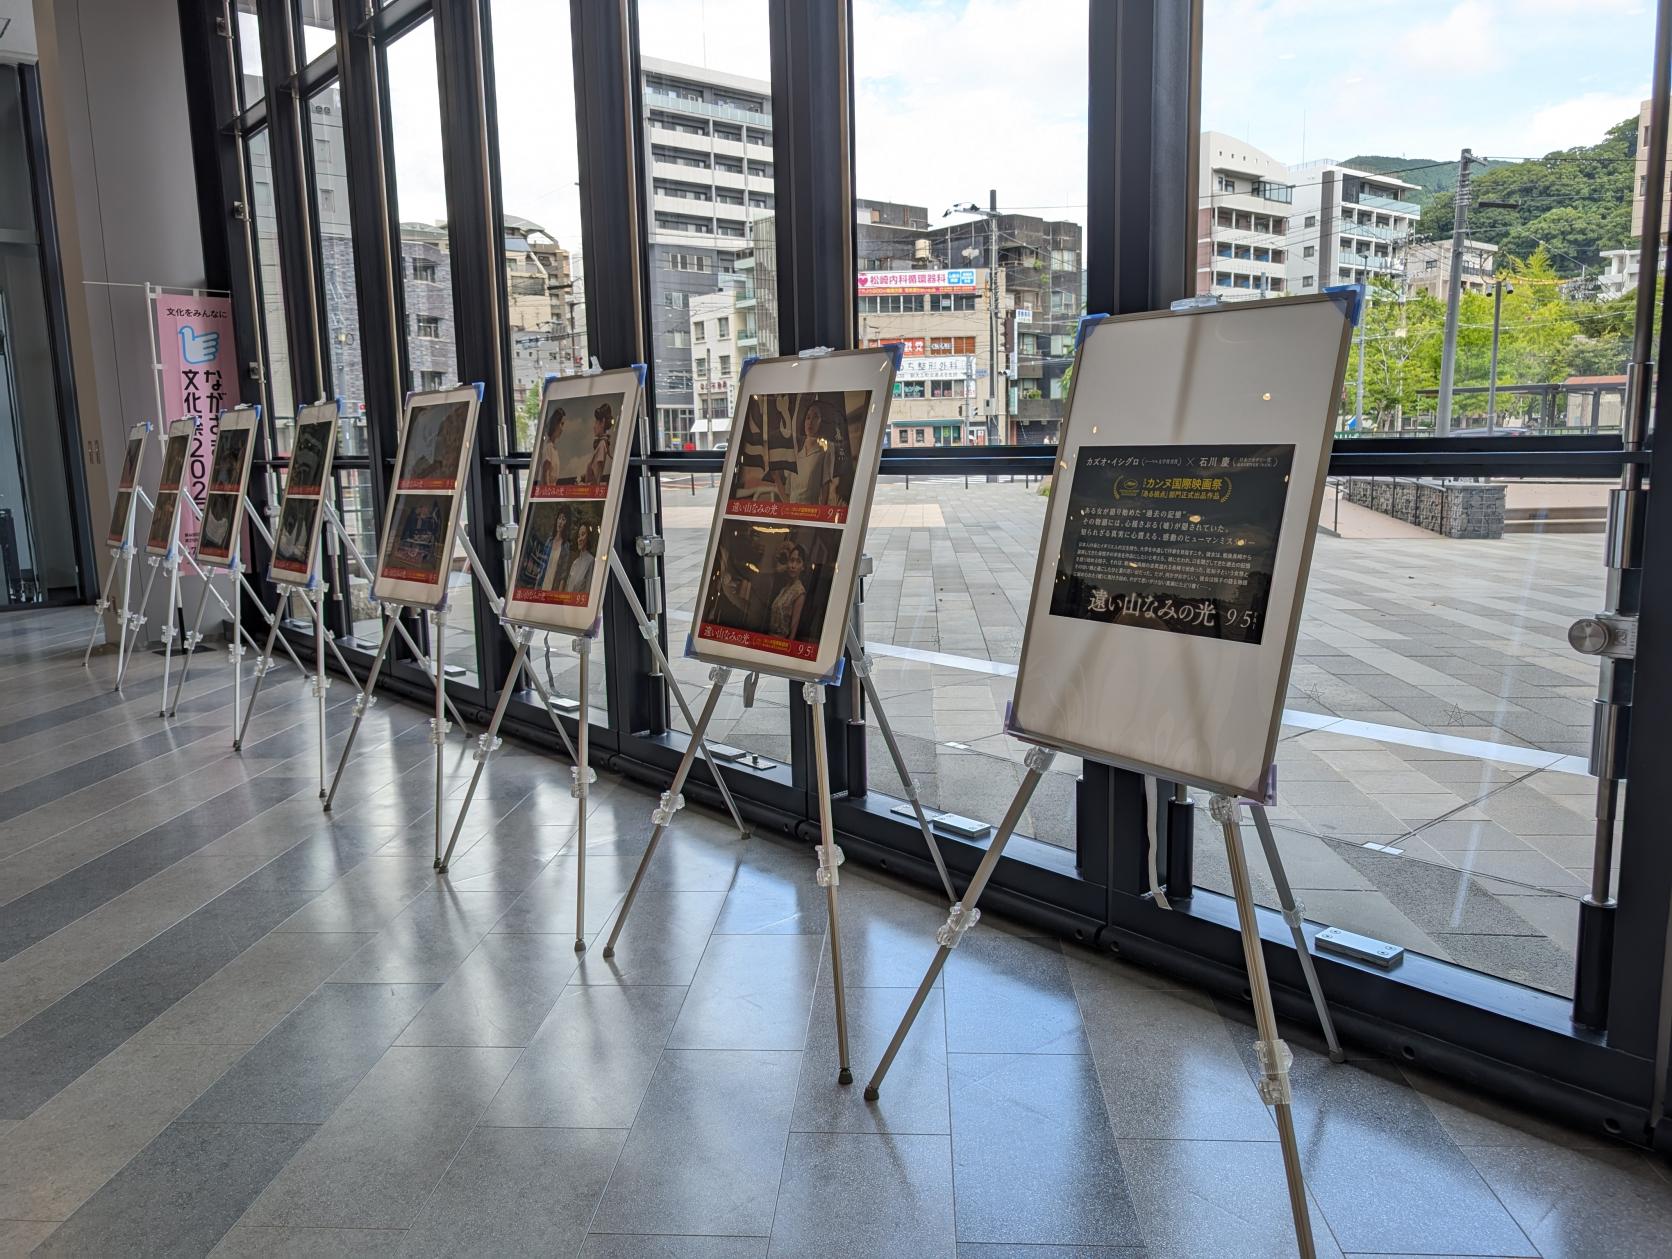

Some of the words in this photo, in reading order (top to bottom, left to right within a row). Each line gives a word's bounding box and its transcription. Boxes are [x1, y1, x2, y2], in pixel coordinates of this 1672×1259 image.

[166, 308, 227, 319] 文化をみんなに
[204, 370, 227, 457] ながさ
[1085, 457, 1140, 466] カズオ・イシグロ
[1086, 587, 1218, 627] 遠い山なみの光
